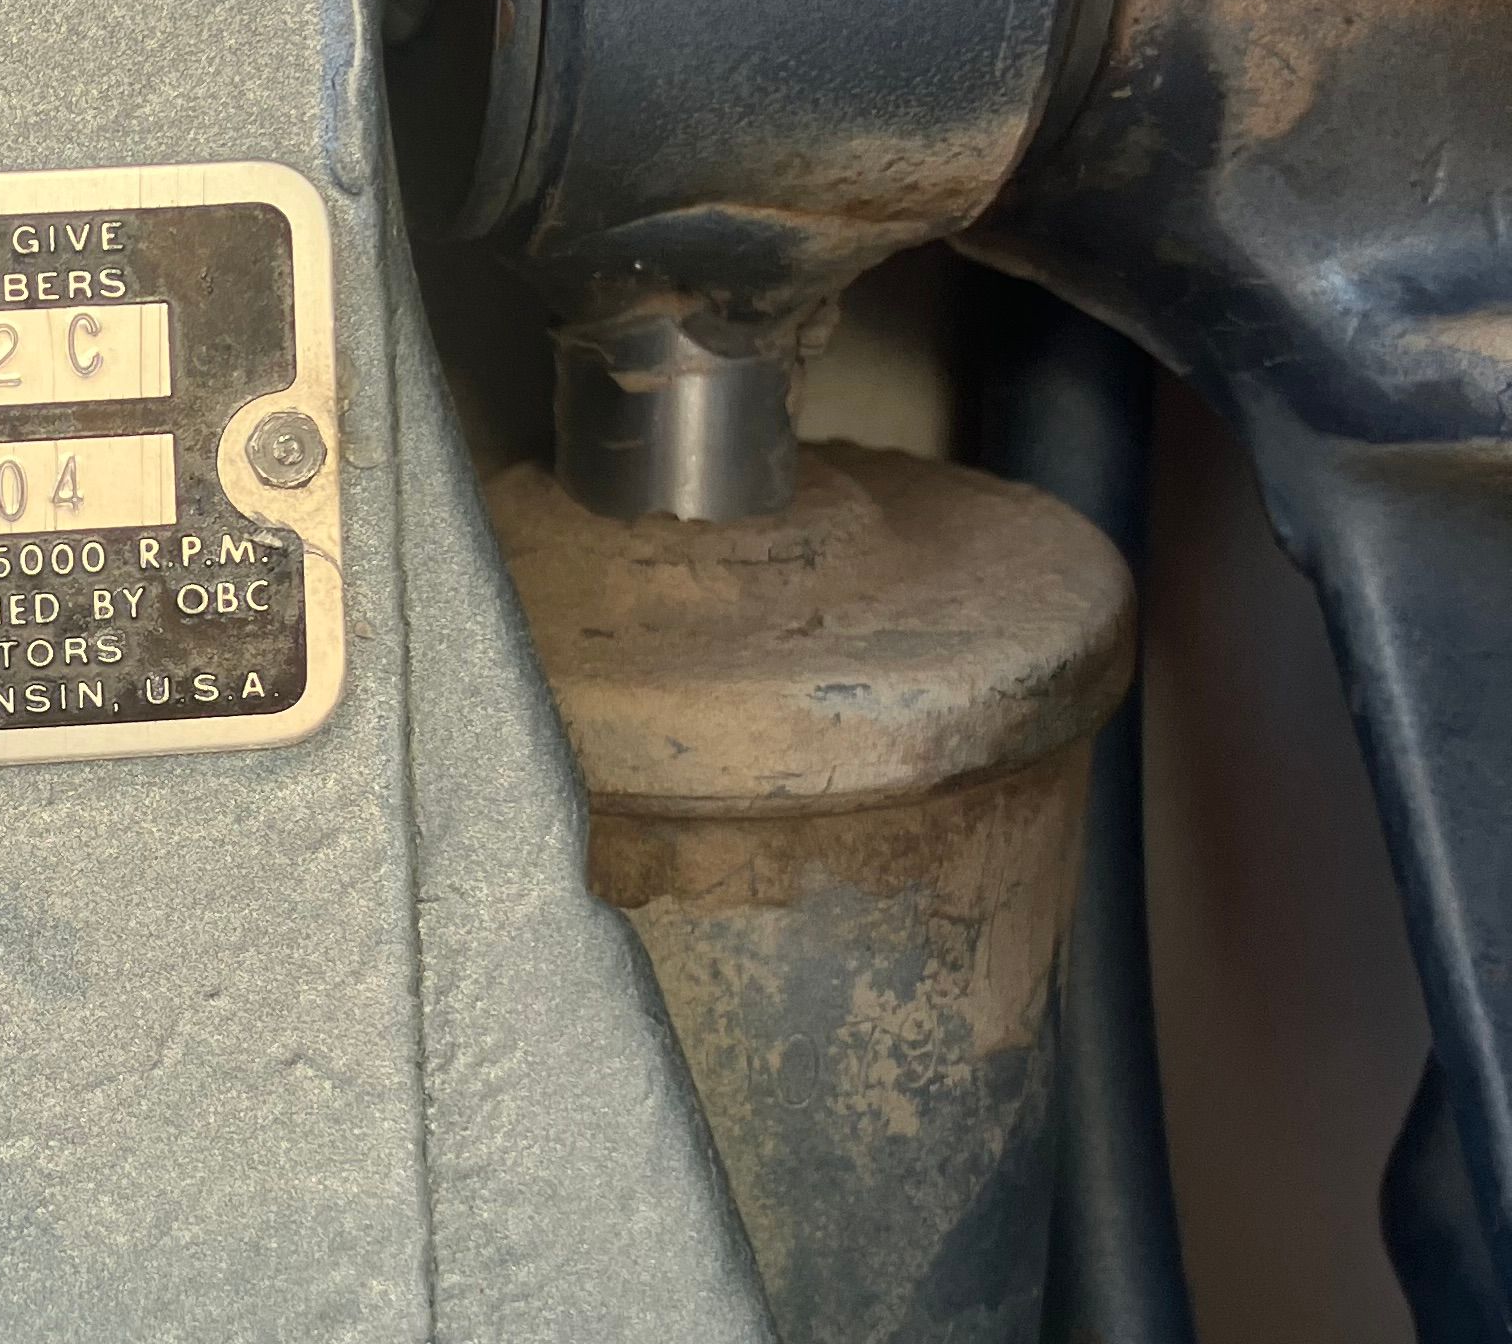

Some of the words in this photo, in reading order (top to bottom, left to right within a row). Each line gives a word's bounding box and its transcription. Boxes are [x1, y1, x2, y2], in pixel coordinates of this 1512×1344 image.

[11, 221, 125, 252] GIVE
[92, 586, 145, 620] BY
[176, 578, 271, 614] OBC
[144, 669, 282, 706] U.S.A.
